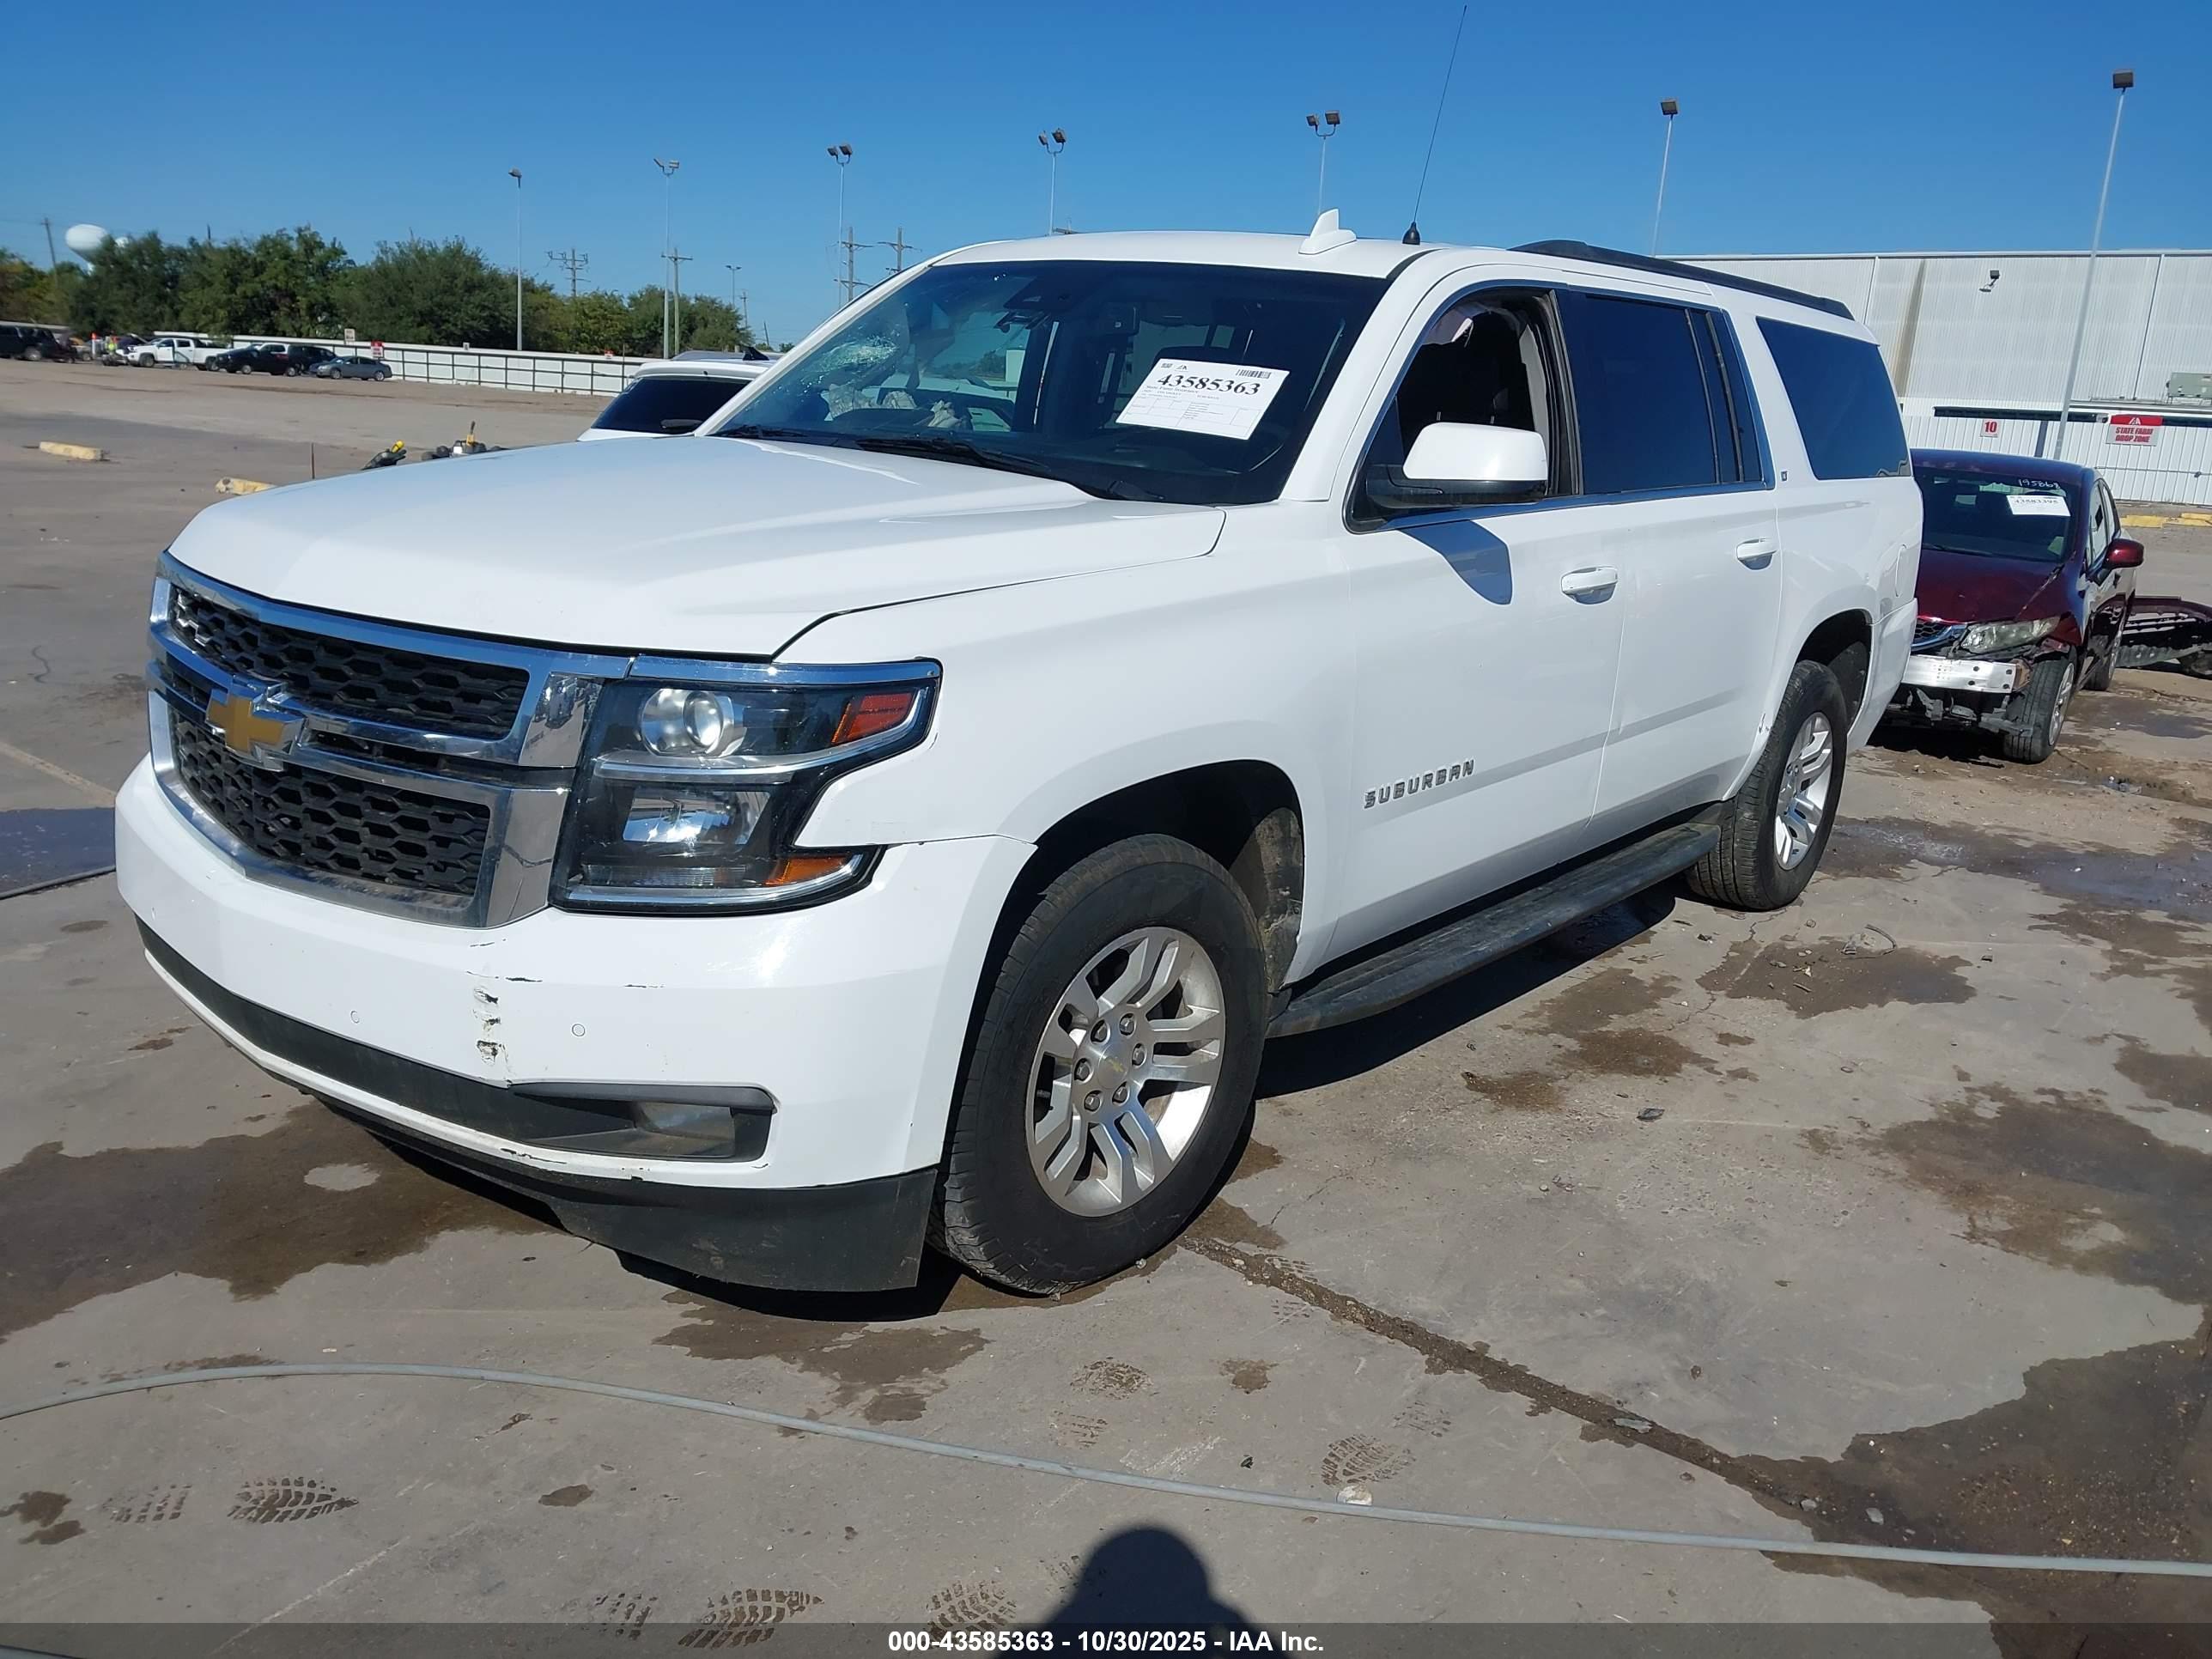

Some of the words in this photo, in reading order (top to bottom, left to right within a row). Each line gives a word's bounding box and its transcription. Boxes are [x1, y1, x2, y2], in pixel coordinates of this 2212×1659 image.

[1157, 374, 1261, 396] 43585363
[1984, 421, 1997, 433] 10
[1364, 759, 1474, 809] SUBURBAN
